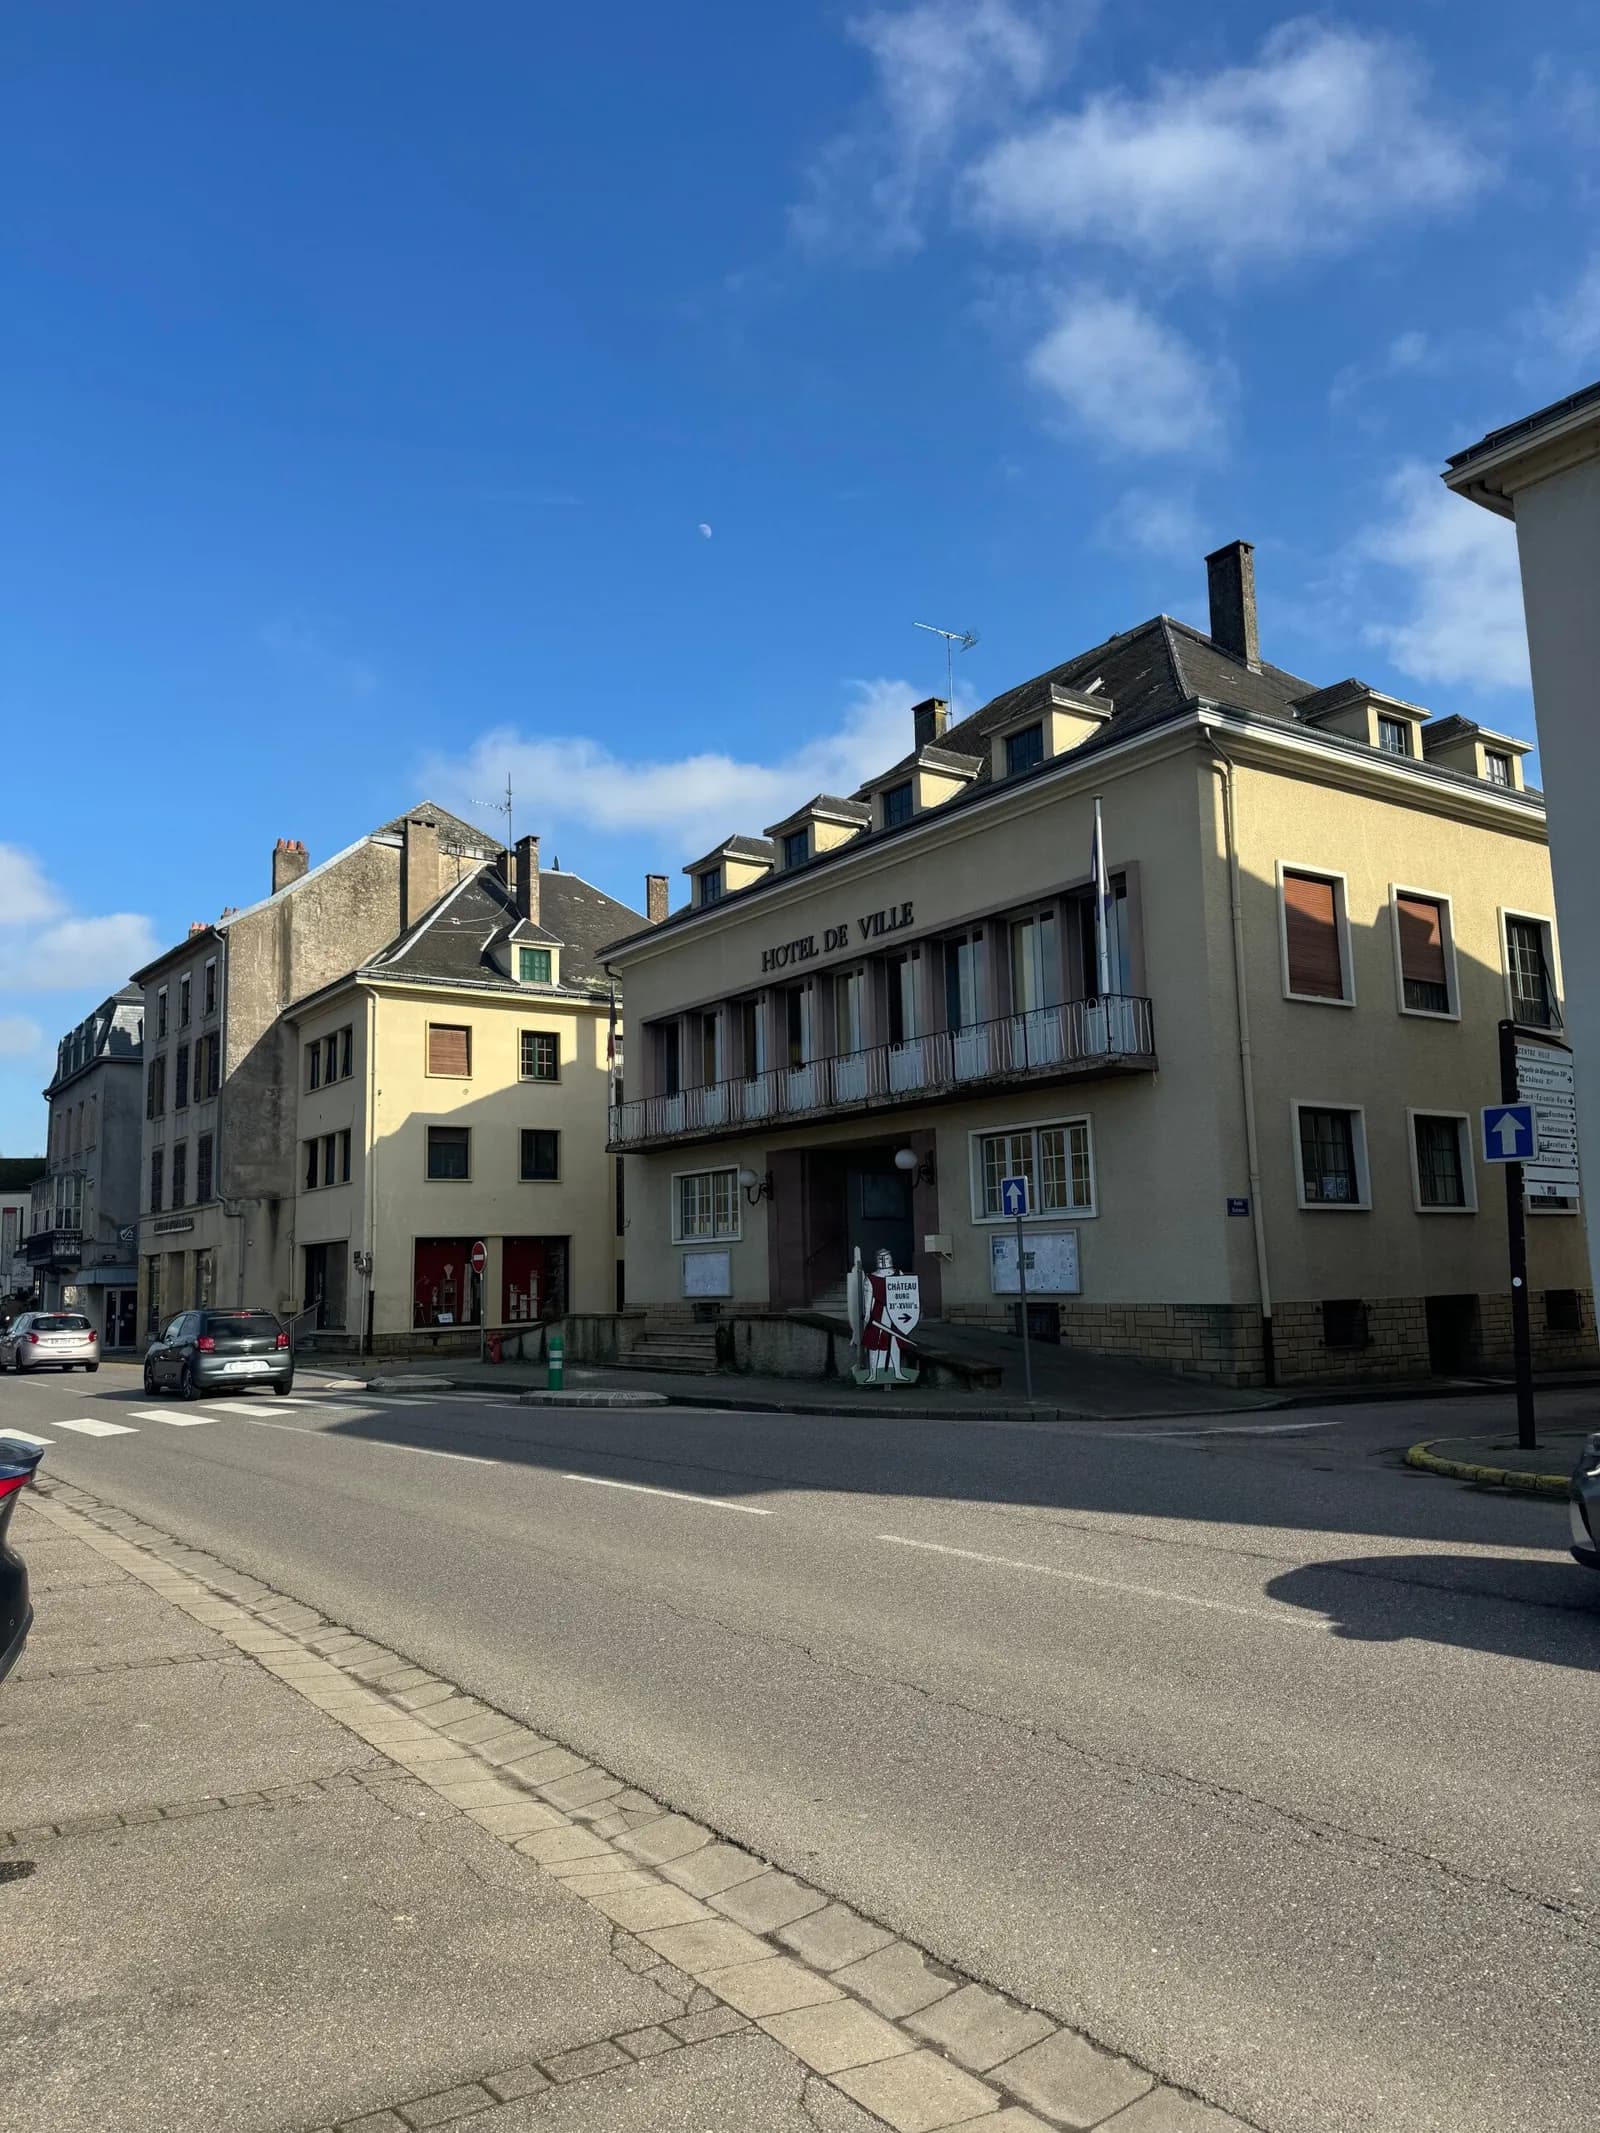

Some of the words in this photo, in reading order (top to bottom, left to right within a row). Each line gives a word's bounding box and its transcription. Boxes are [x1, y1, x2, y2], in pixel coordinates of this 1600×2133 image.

[761, 935, 819, 972] HOTEL
[823, 924, 849, 952] DE
[857, 901, 914, 940] VILLE
[887, 1281, 917, 1291] CHÂTEAU
